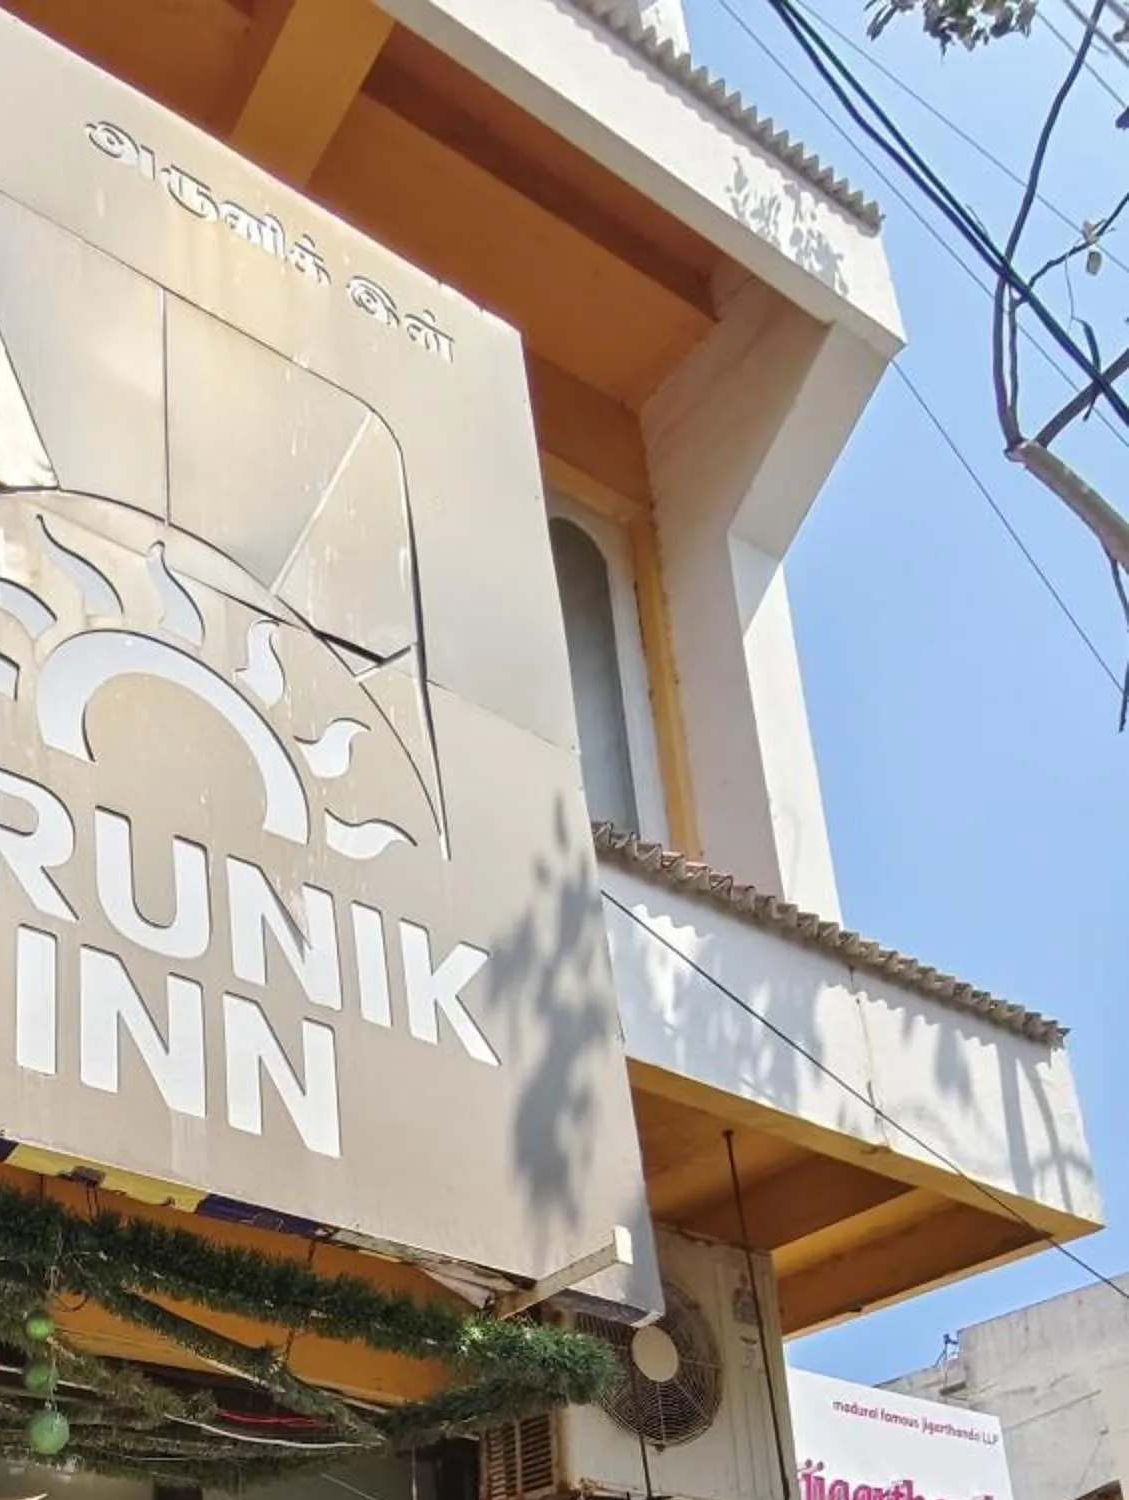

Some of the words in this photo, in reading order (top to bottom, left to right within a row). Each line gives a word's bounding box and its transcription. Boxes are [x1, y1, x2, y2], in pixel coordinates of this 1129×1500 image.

[16, 923, 342, 1159] INN
[880, 1407, 920, 1429] famous
[982, 1430, 1000, 1446] LLP
